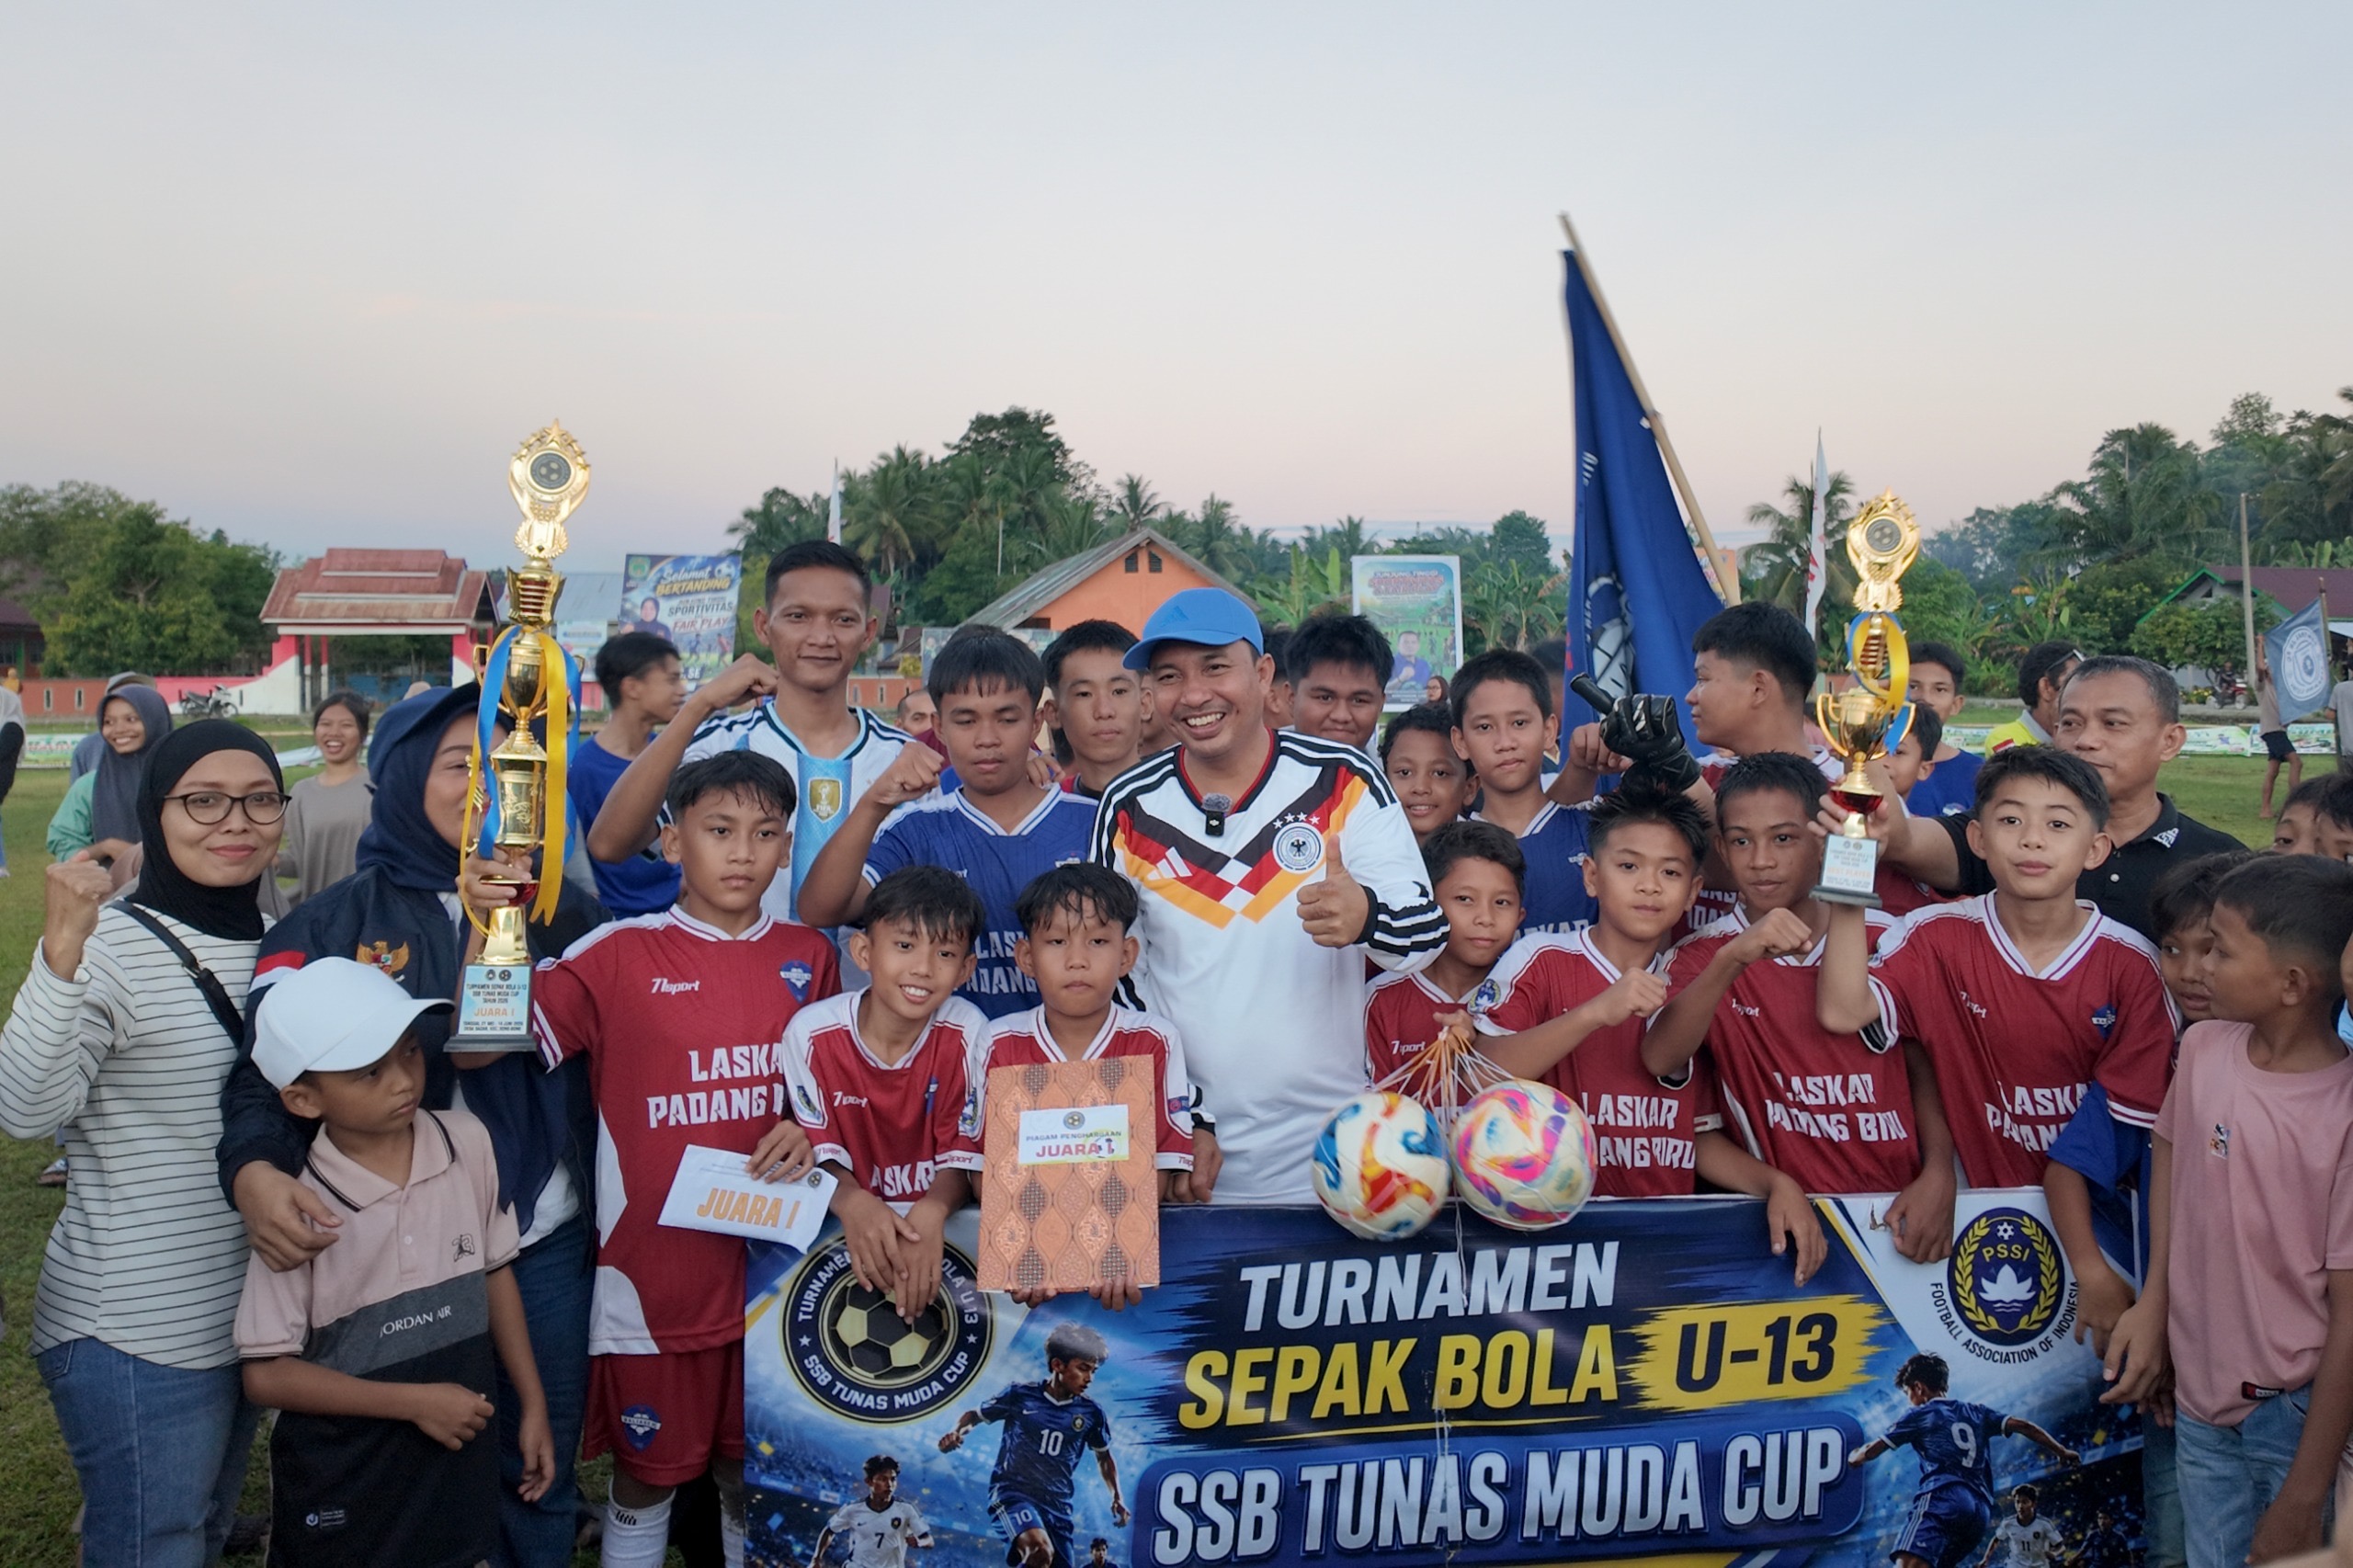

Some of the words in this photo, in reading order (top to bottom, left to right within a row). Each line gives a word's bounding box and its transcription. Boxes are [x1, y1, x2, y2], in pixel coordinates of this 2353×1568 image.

[655, 577, 732, 597] BERTANDING
[661, 565, 711, 584] Selamat
[668, 602, 733, 617] SPORTIVITAS
[674, 619, 697, 632] FAIR
[701, 617, 729, 631] PLAY
[974, 930, 1029, 959] LAS
[474, 1007, 507, 1017] JUARA
[688, 1042, 782, 1083] LASKA
[646, 1085, 767, 1130] PADANG
[1581, 1092, 1679, 1131] LASKAR
[1996, 1080, 2089, 1117] LASKA
[1026, 1133, 1057, 1142] PIAGAM
[1060, 1131, 1122, 1140] PENGHARGAAN
[1036, 1142, 1100, 1158] JUARA
[870, 1160, 936, 1197] ASKAR
[697, 1187, 784, 1229] JUARA
[1982, 1244, 2029, 1262] PSSI
[941, 1258, 966, 1288] OLA
[1239, 1241, 1620, 1332] TURNAMEN
[961, 1290, 974, 1303] U
[379, 1312, 433, 1338] JORDAN
[437, 1305, 452, 1321] AIR
[964, 1307, 979, 1324] 13
[1930, 1282, 1962, 1340] FOOTBALL
[1961, 1337, 2039, 1364] ASSOCIATION
[2039, 1335, 2053, 1353] OF
[804, 1354, 832, 1386] SSB
[832, 1381, 888, 1411] TUNAS
[894, 1381, 944, 1409] MUDA
[943, 1351, 970, 1383] CUP
[1177, 1337, 1417, 1429] SEPAK
[1432, 1324, 1619, 1411] BOLA
[1675, 1312, 1838, 1393] U-13
[1039, 1428, 1063, 1457] 10
[1950, 1422, 1977, 1469] 9
[1153, 1468, 1282, 1565] SSB
[1300, 1450, 1508, 1551] TUNAS
[1522, 1440, 1706, 1539] MUDA
[1723, 1426, 1843, 1526] CUP
[1014, 1509, 1033, 1526] 10
[874, 1532, 884, 1549] 7
[2021, 1540, 2030, 1551] 11
